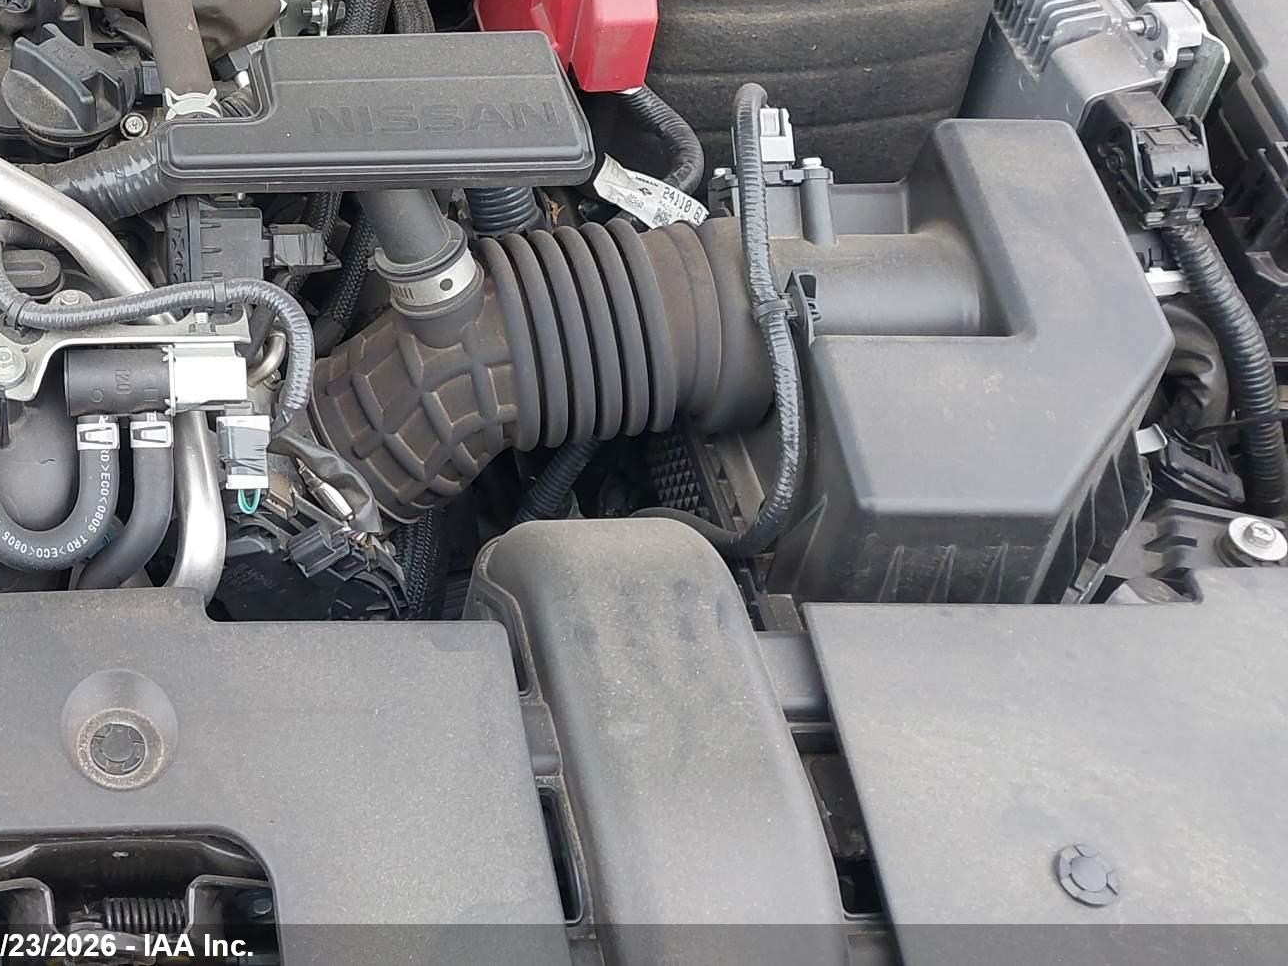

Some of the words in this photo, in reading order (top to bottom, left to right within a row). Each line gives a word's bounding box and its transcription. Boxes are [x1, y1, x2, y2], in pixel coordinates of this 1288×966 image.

[305, 101, 562, 134] NISSAN
[88, 449, 111, 534] RD>ECO<0805
[2, 531, 88, 558] TRD>ECO<0805
